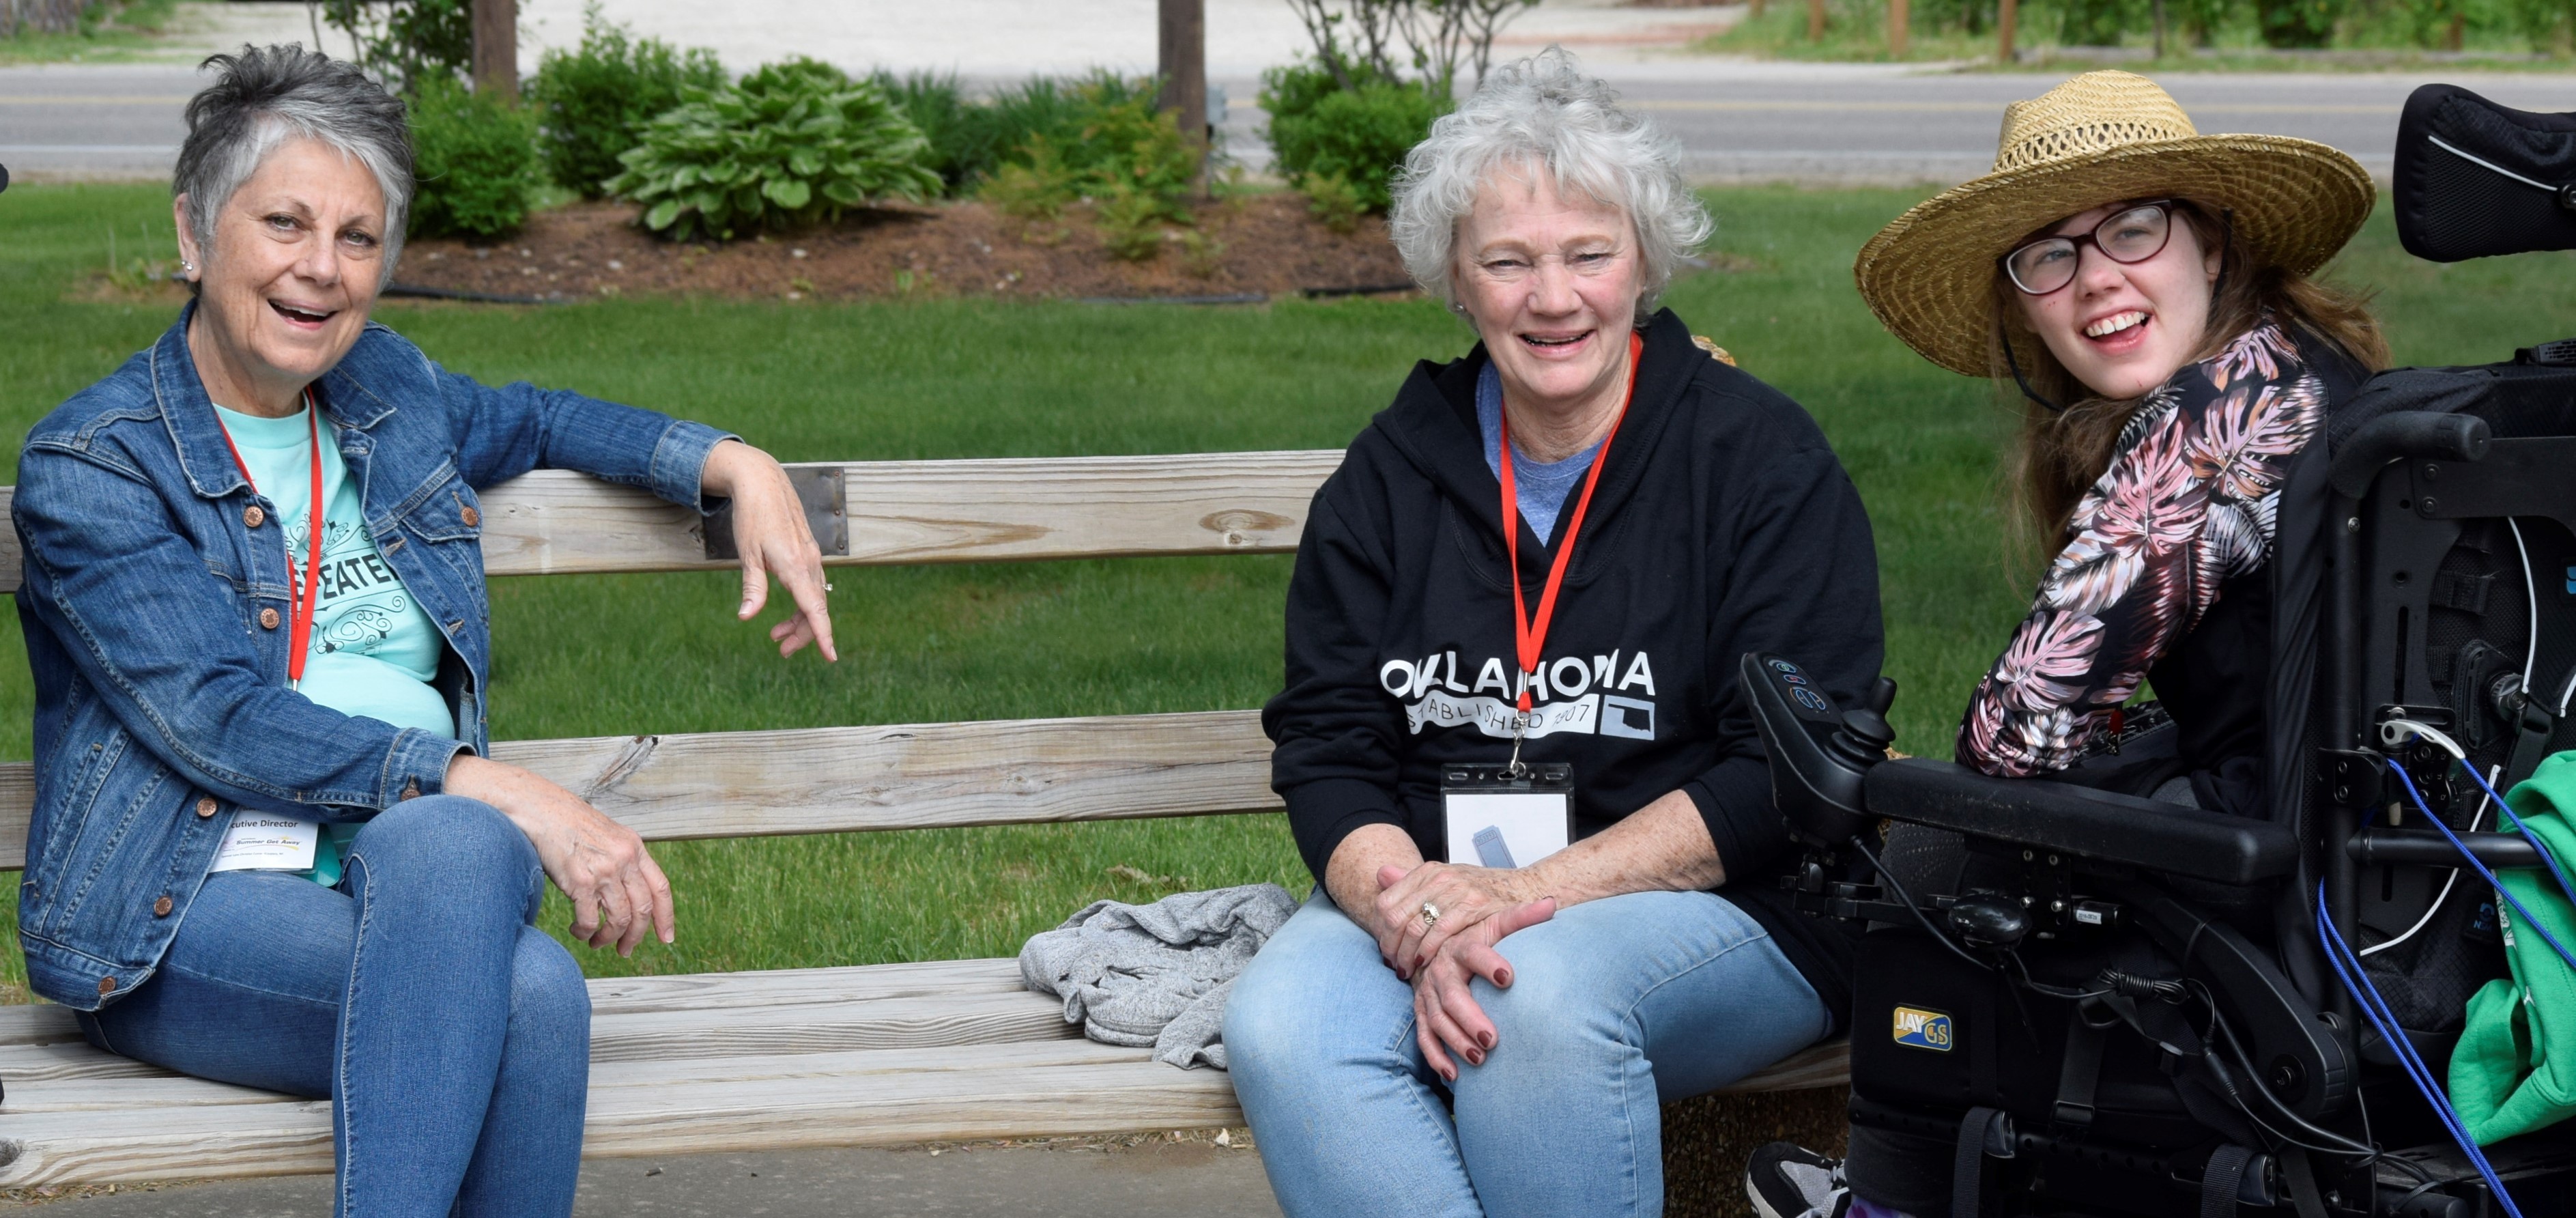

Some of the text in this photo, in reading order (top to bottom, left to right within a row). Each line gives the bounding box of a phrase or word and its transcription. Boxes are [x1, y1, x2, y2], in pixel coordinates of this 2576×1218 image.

[1380, 649, 1656, 701] OKLAHOMA
[1407, 698, 1543, 730] STABLISHED
[230, 821, 257, 829] cutive
[1896, 1012, 1948, 1045] JAY GS
